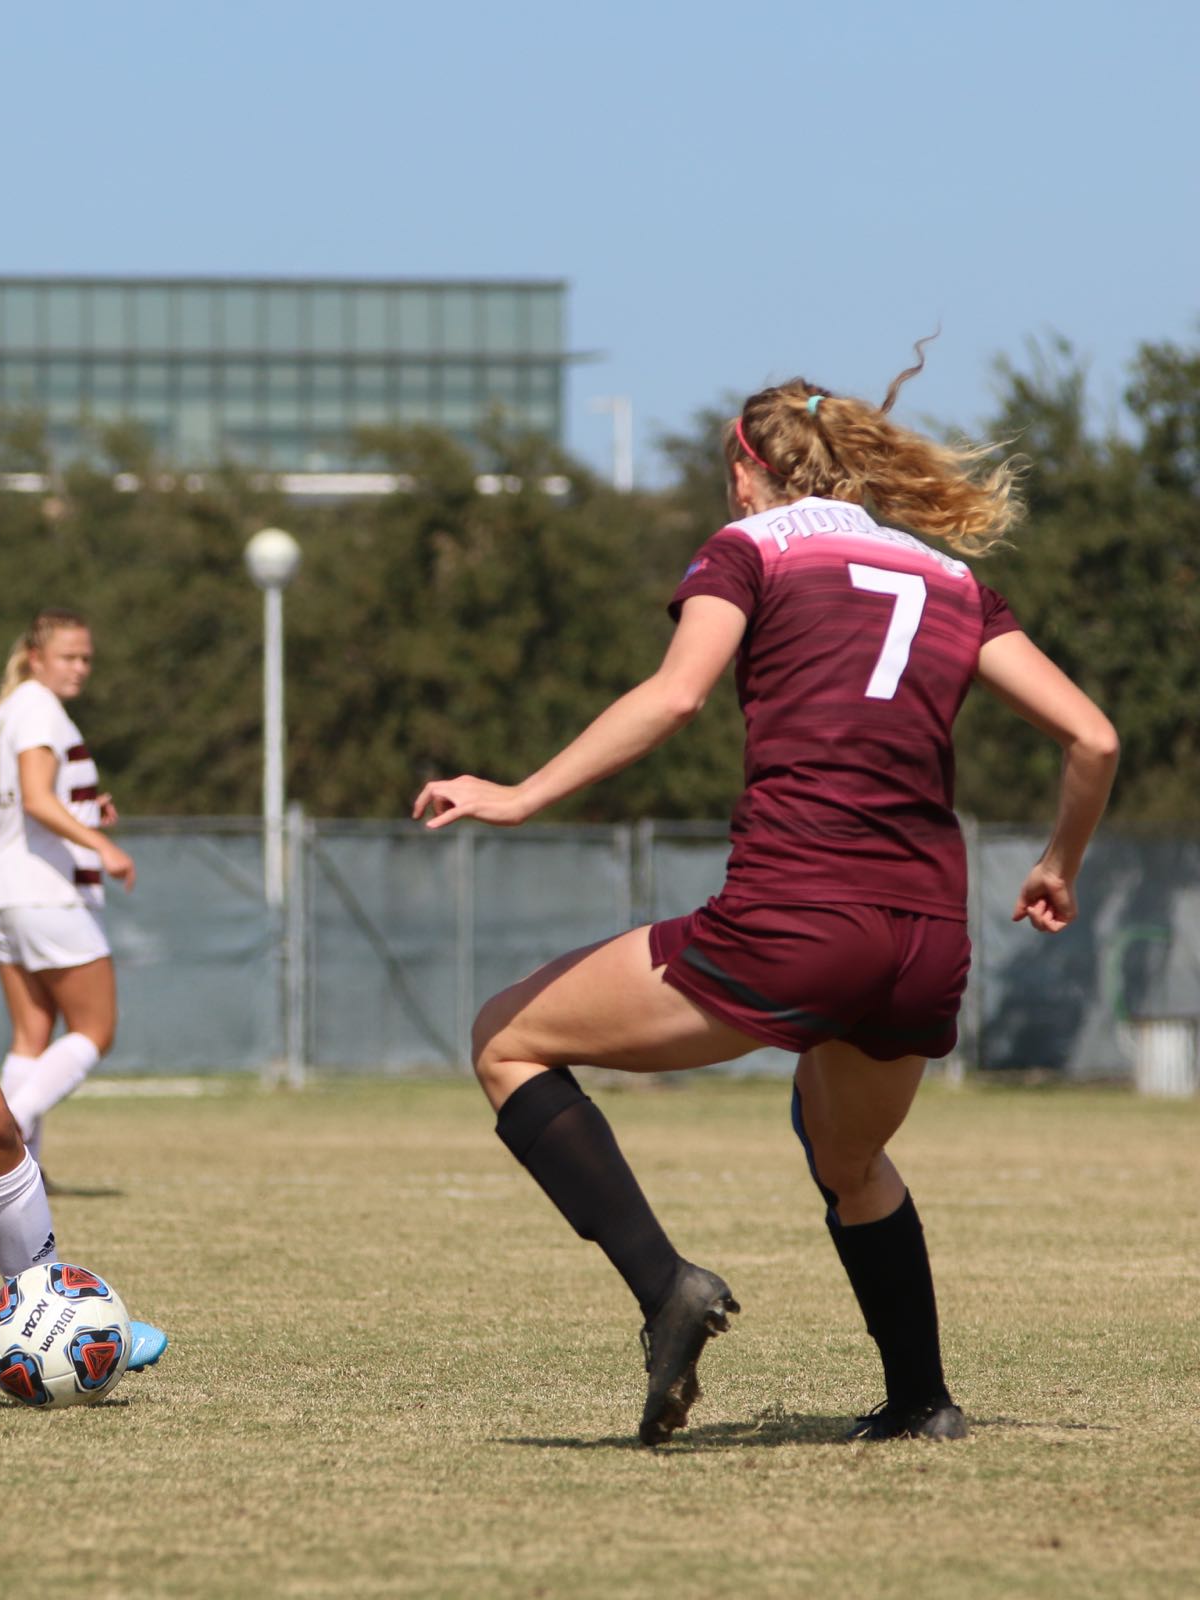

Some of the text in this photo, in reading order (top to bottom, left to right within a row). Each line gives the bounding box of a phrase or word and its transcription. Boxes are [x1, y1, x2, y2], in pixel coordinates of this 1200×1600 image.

[847, 562, 928, 700] 7
[21, 1298, 49, 1338] NCAA
[39, 1307, 77, 1352] Wilson
